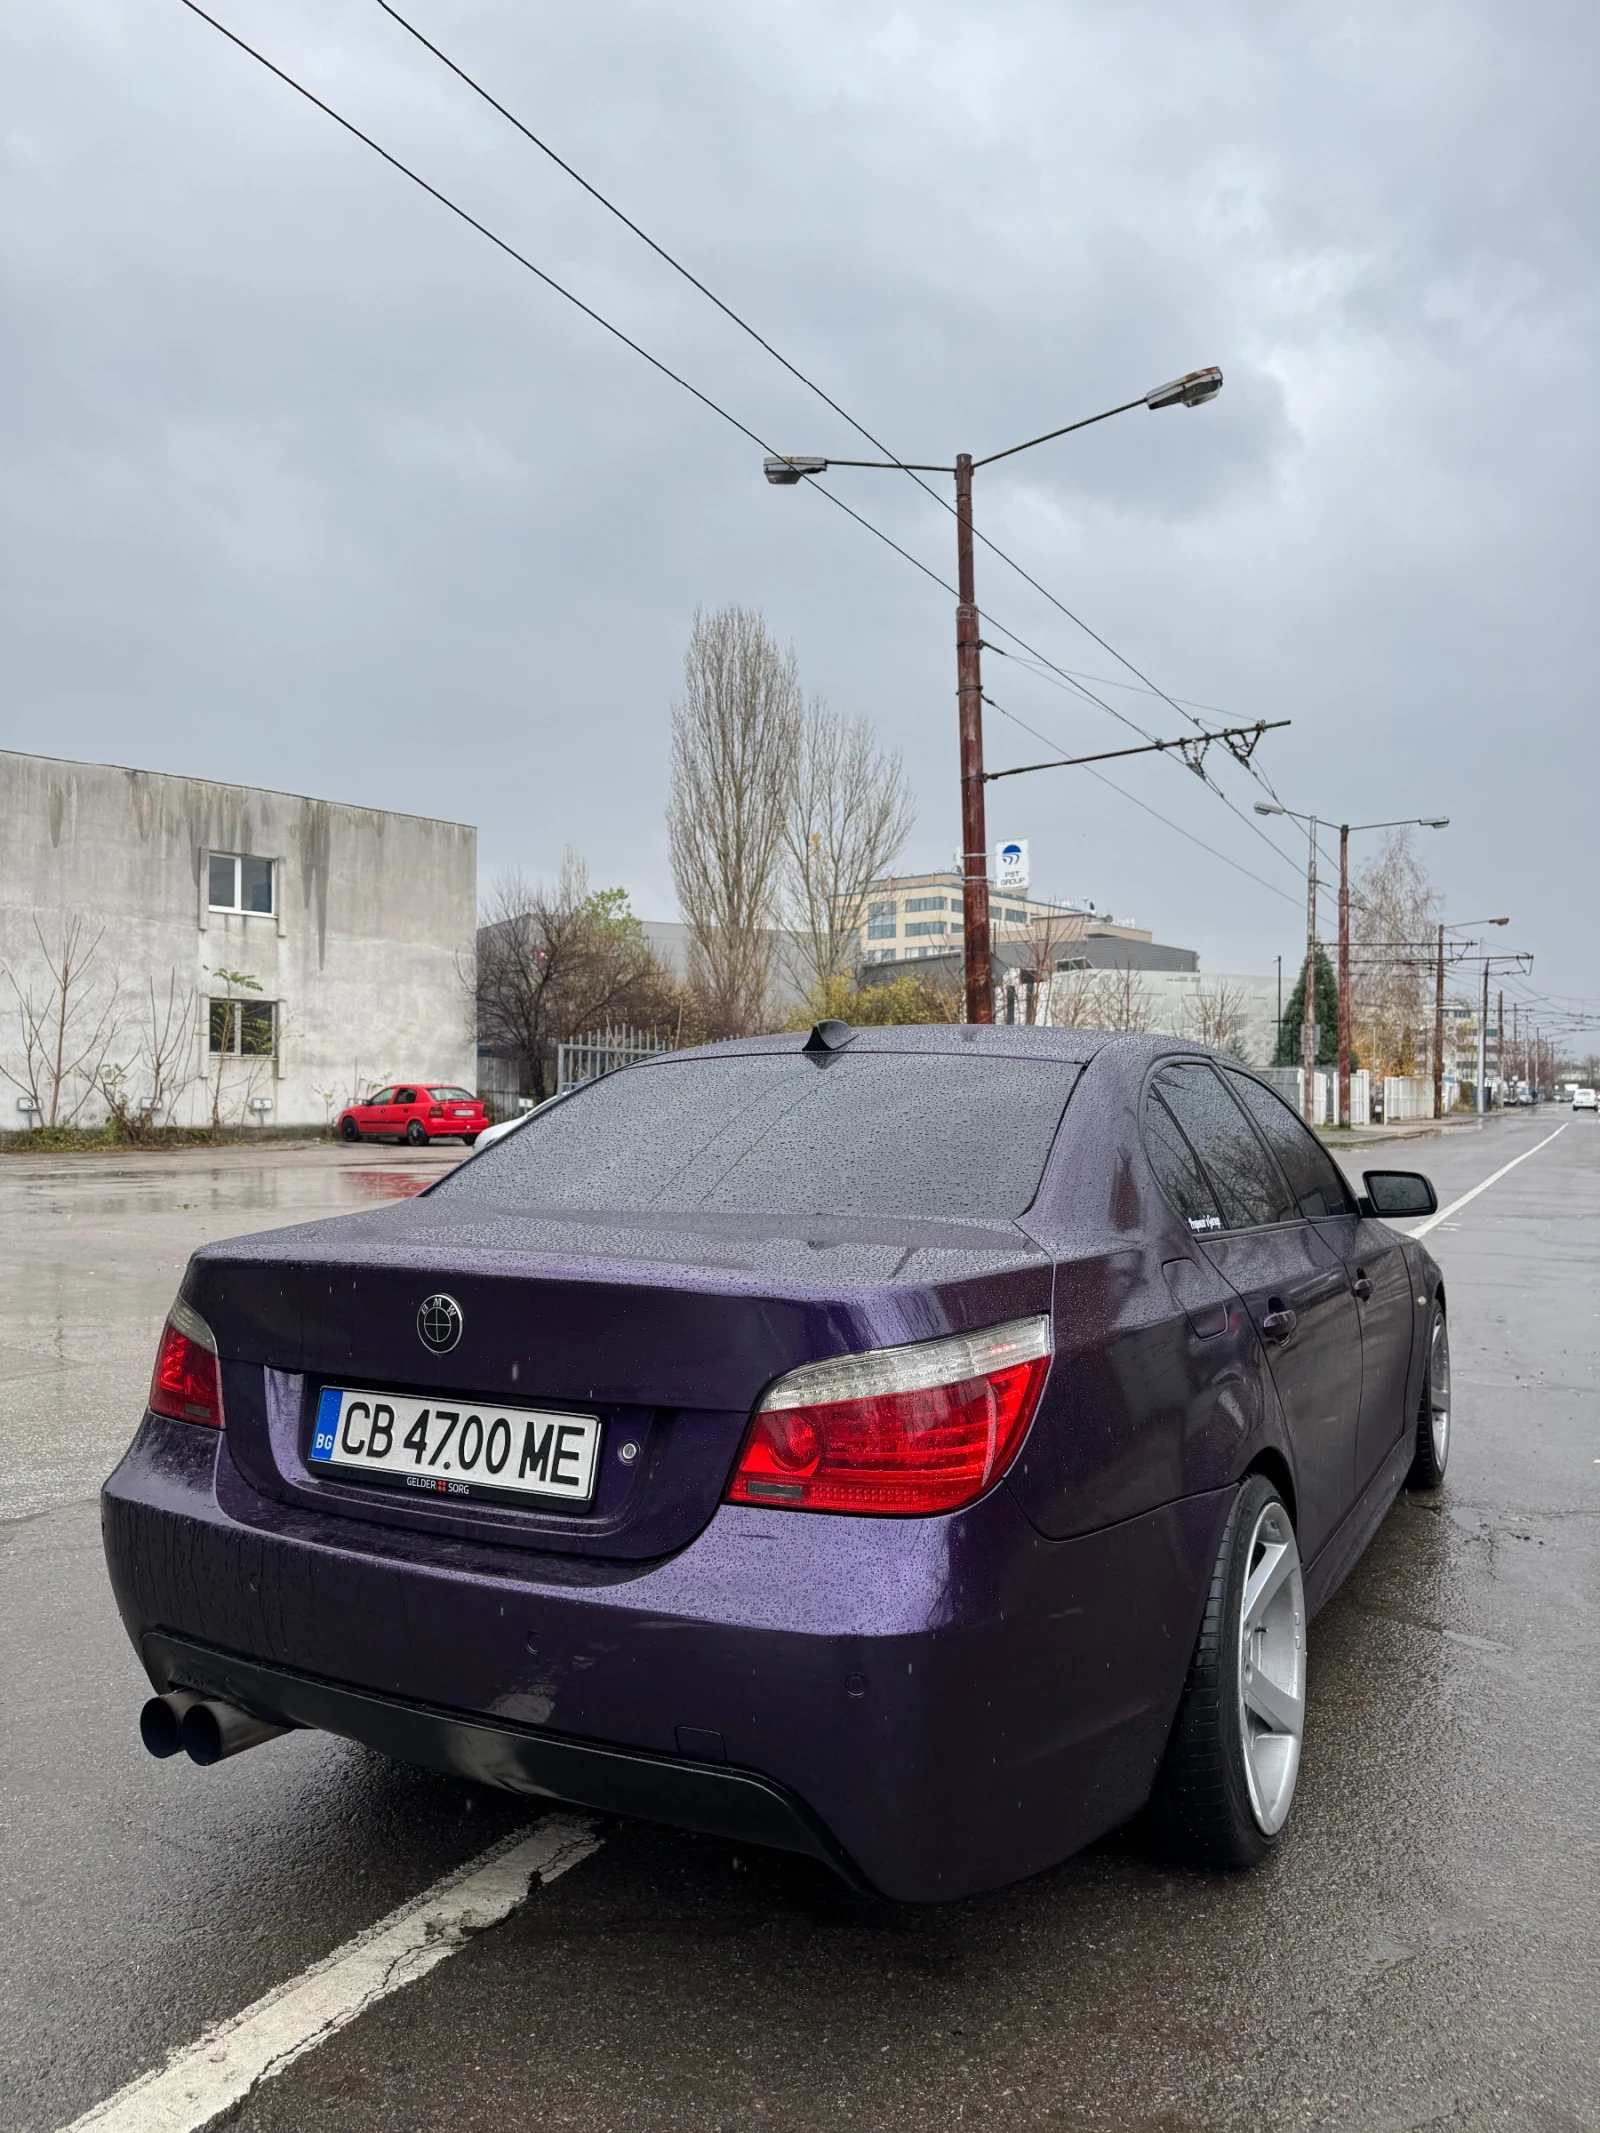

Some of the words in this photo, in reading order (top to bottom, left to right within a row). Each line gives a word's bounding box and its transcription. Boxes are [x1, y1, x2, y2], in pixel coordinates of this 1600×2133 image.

[1000, 877, 1025, 886] GROUP
[421, 1297, 457, 1317] BMW
[315, 1432, 333, 1451] BG
[341, 1401, 395, 1458] CB
[518, 1421, 586, 1487] ME
[406, 1476, 437, 1490] GELDER
[448, 1482, 470, 1495] SORG
